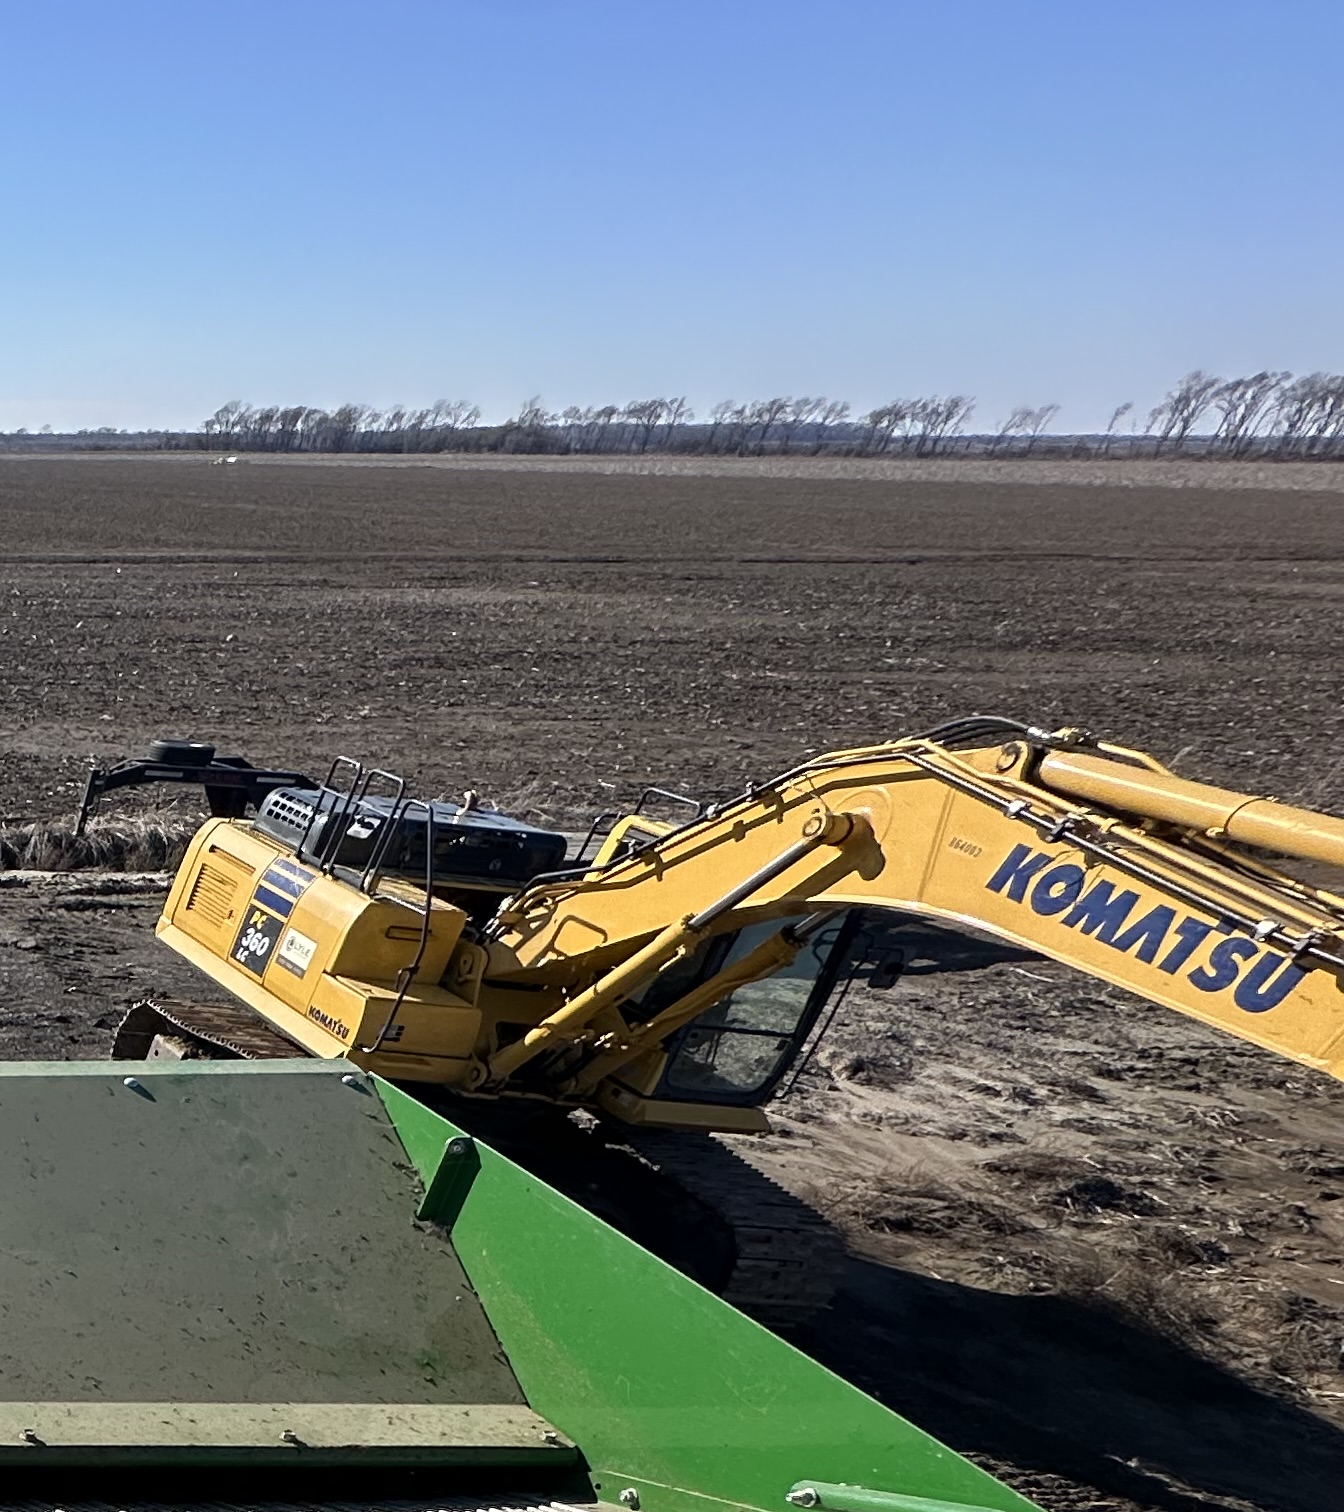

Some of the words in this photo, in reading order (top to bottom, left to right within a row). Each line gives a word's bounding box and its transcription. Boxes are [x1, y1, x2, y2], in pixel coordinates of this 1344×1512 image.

[249, 911, 268, 930] PC
[985, 843, 1311, 1012] KOMATSU
[241, 928, 270, 956] 360
[308, 1005, 351, 1040] KOMATSU
